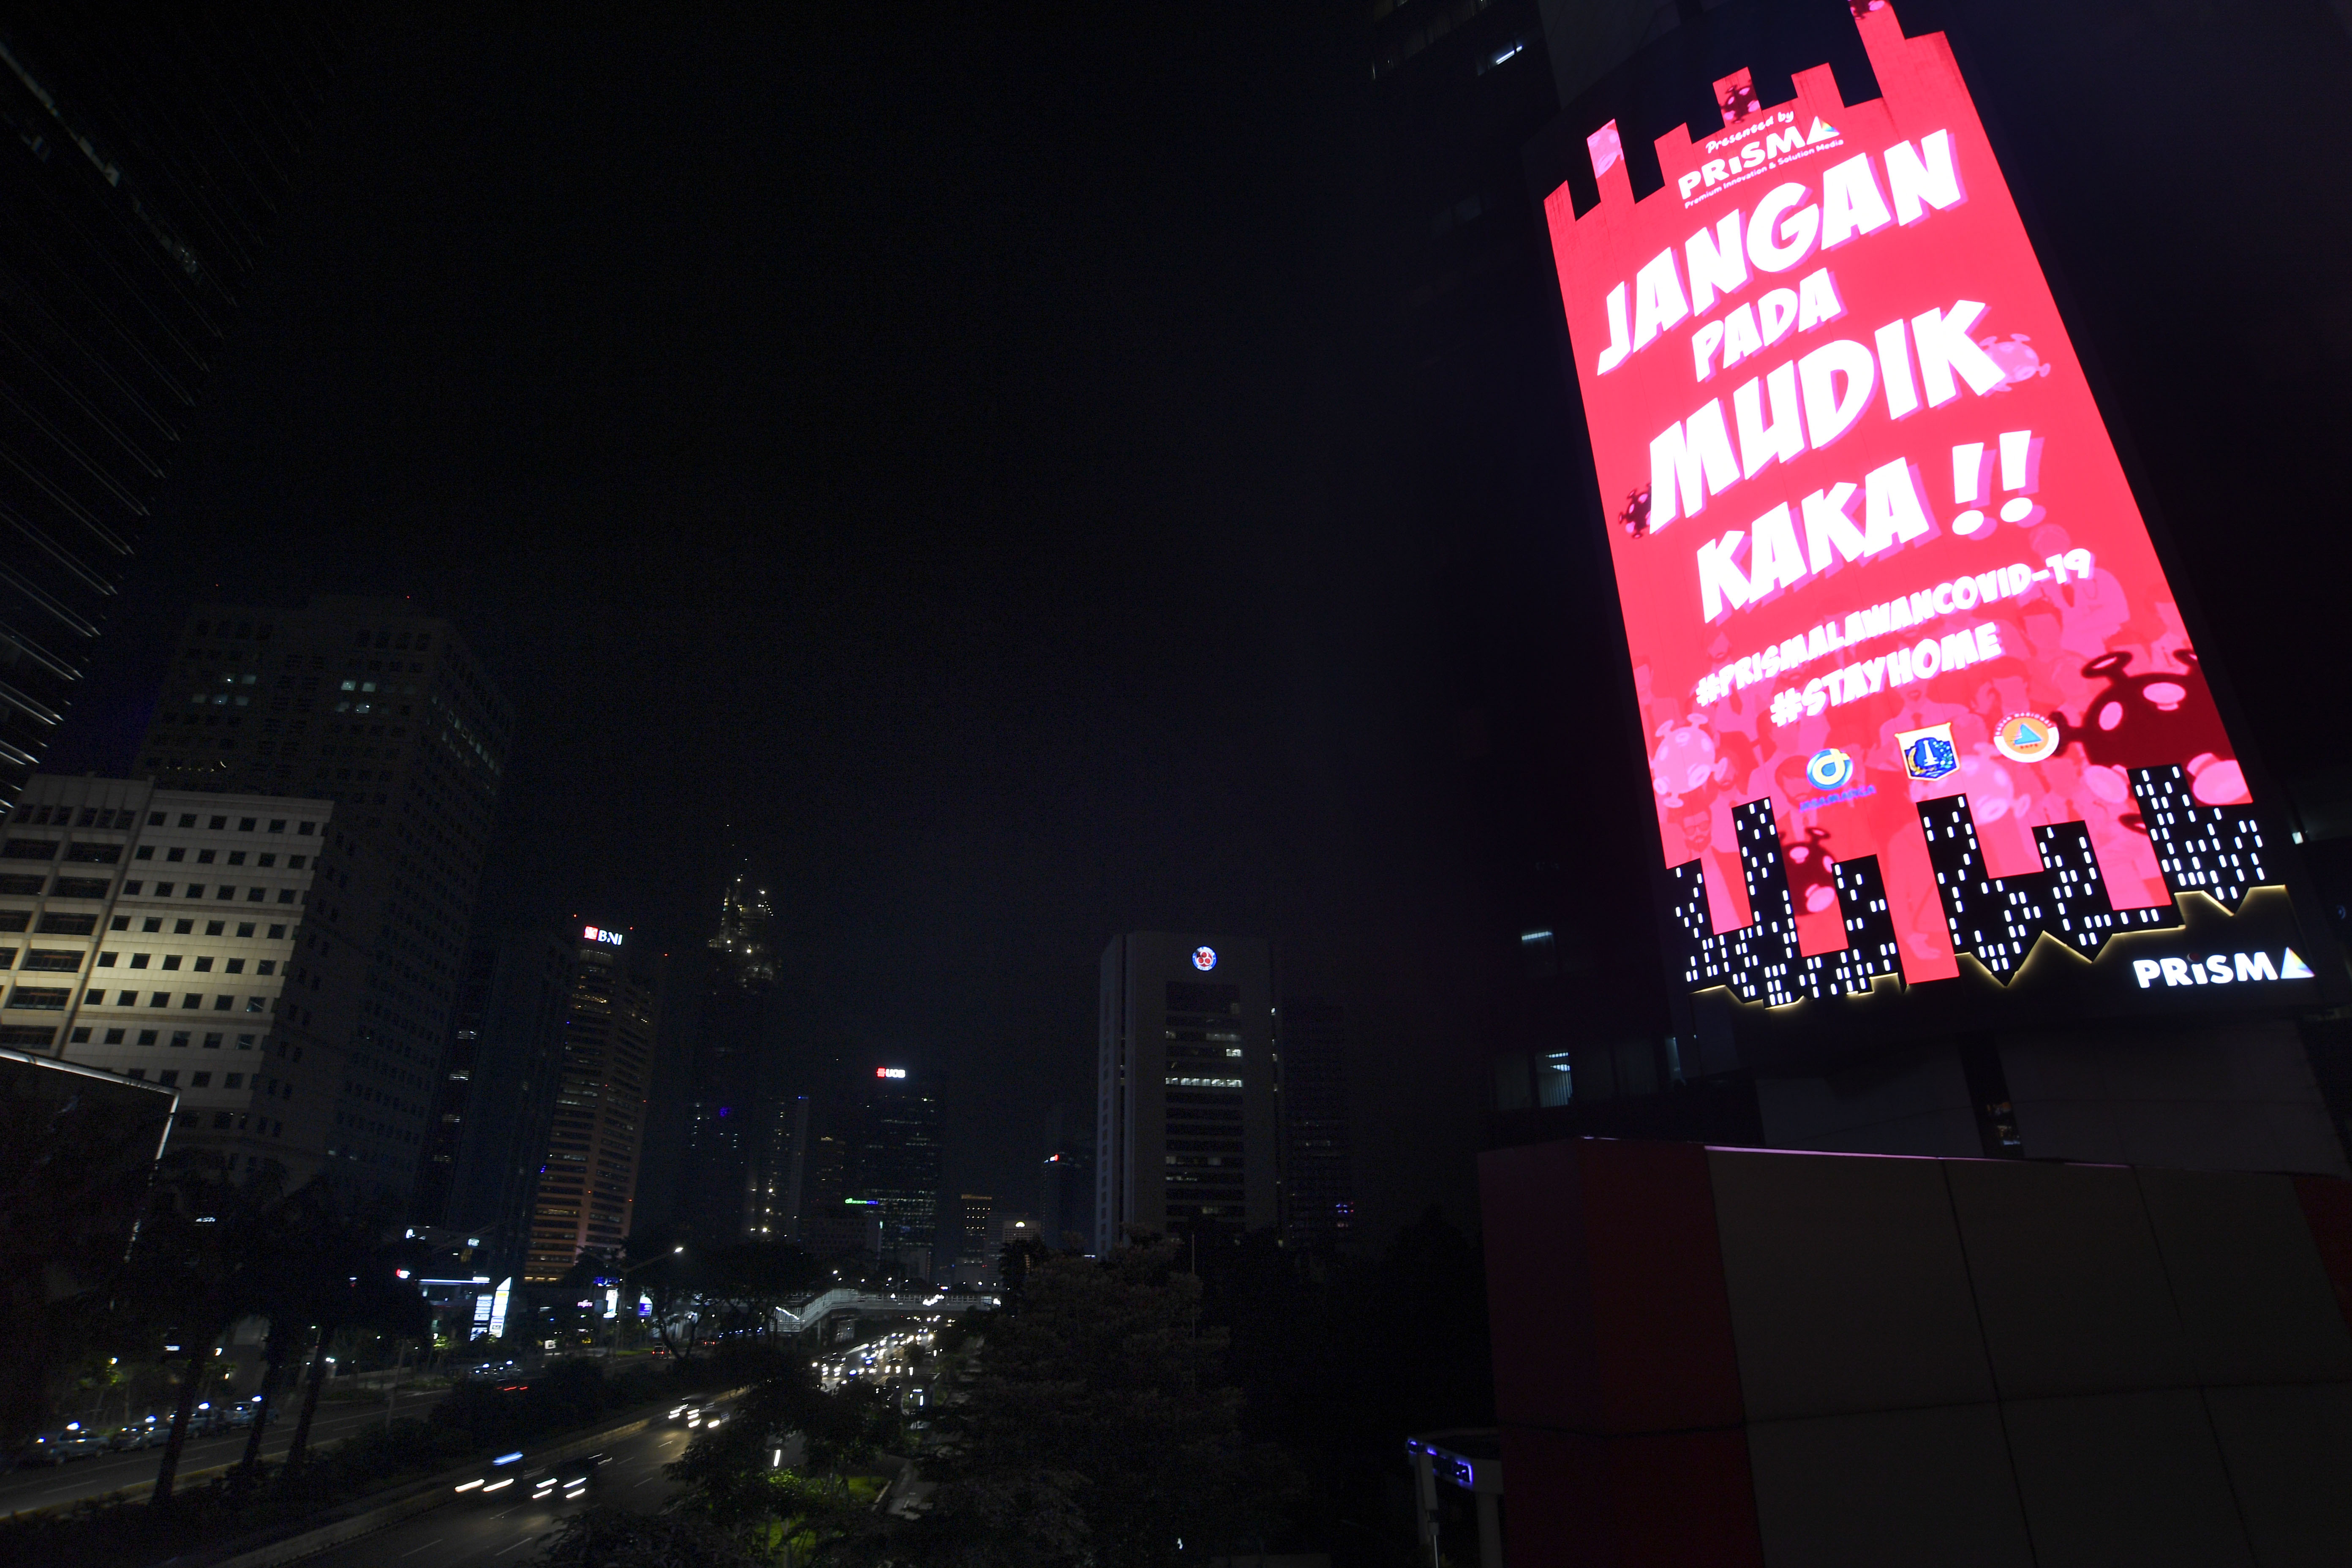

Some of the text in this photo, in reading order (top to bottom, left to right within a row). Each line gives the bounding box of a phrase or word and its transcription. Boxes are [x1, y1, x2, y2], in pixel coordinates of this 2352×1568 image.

[1685, 139, 1844, 209] Premium Innovation & Solution Media
[1705, 111, 1794, 153] Presented by
[1598, 129, 1960, 375] JANGAN
[1692, 268, 1841, 382] PADA
[1650, 300, 2006, 534] MUDIK
[1697, 457, 1929, 623] KAKA
[1696, 549, 2091, 706] #PRISMALAWANCOVID-19
[1770, 622, 2001, 727] #STAYHOME
[598, 930, 623, 945] BNI
[886, 1069, 906, 1078] UOB
